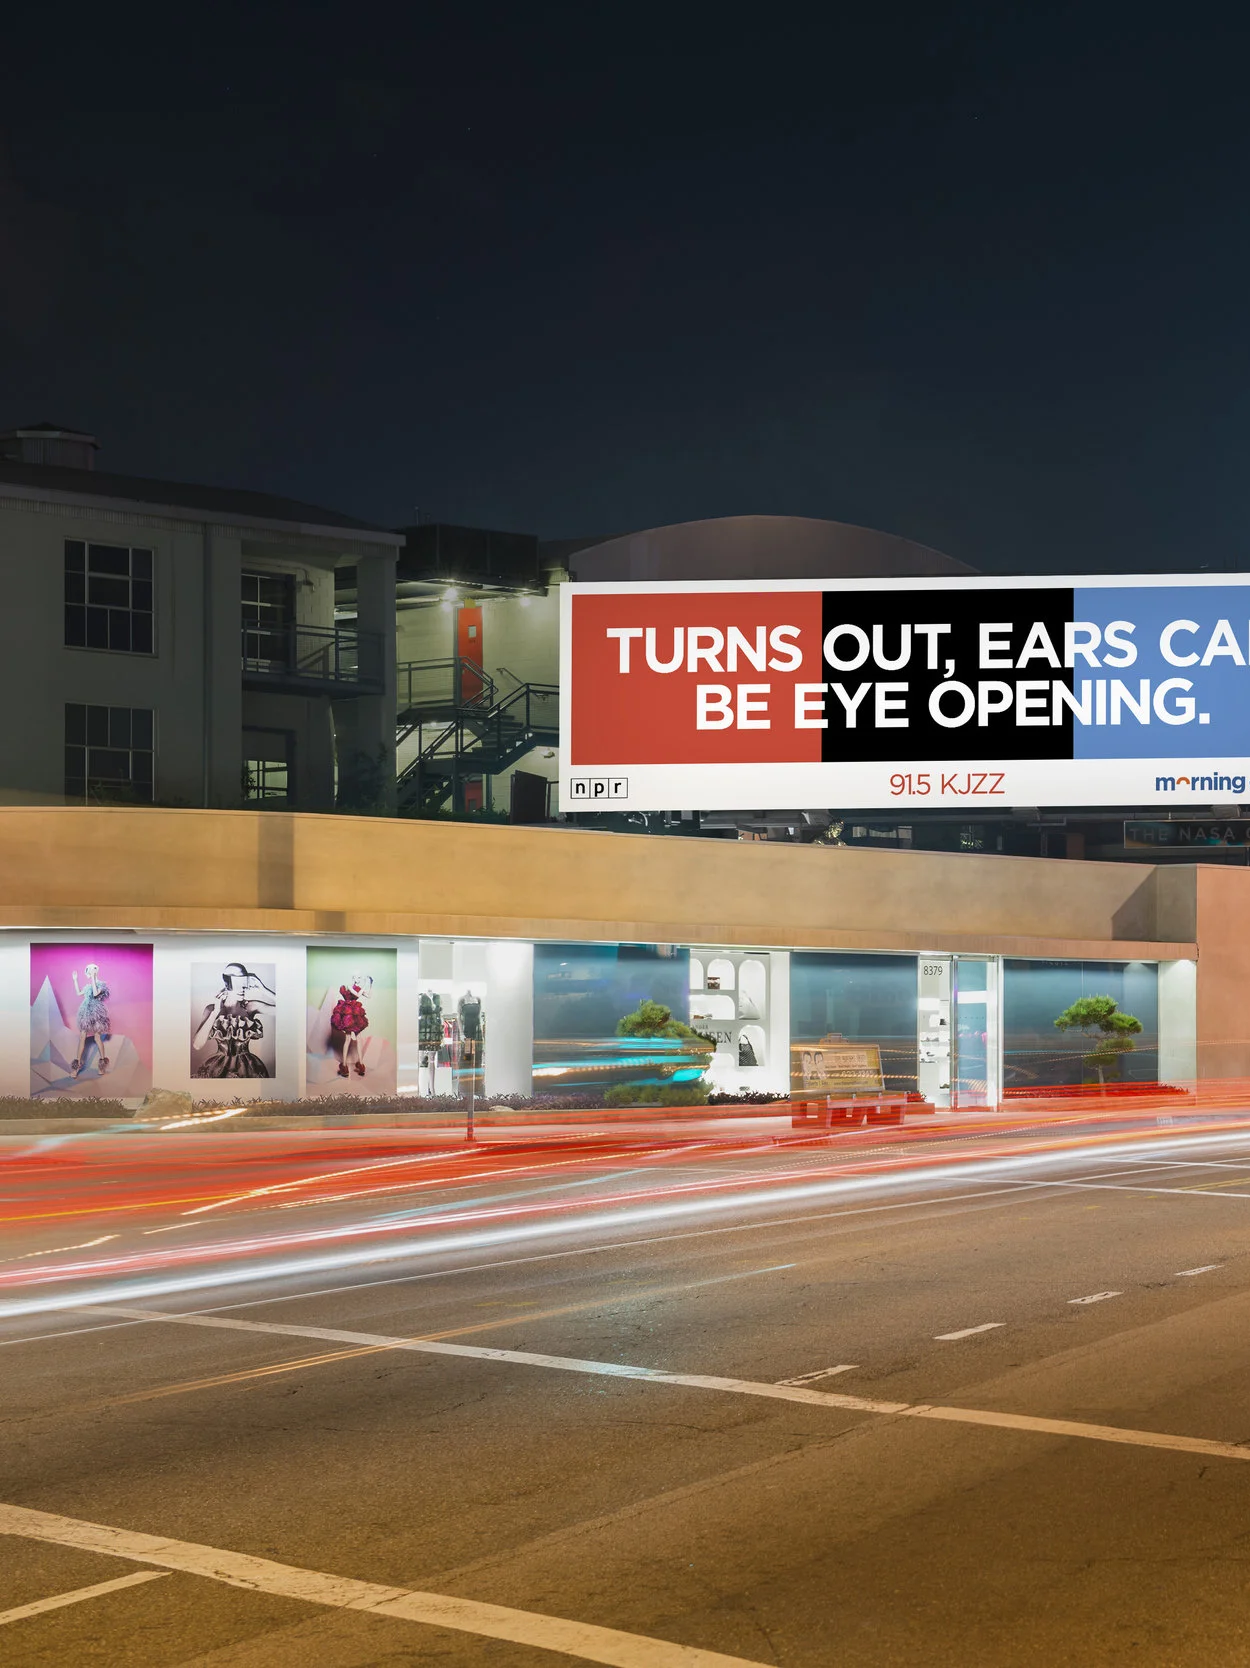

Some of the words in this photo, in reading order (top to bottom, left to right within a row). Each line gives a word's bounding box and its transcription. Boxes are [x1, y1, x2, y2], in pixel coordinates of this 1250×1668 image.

[606, 624, 803, 674] TURNS
[822, 623, 956, 678] OUT,
[978, 620, 1138, 669] EARS
[696, 683, 771, 730] BE
[794, 681, 910, 729] EYE
[928, 677, 1211, 729] OPENING.
[575, 782, 622, 798] npr
[889, 773, 931, 796] 91.5
[941, 773, 1005, 795] KJZZ
[1155, 771, 1246, 794] morning
[1129, 828, 1169, 842] THE
[1178, 827, 1236, 841] NASA
[923, 965, 943, 976] 8379
